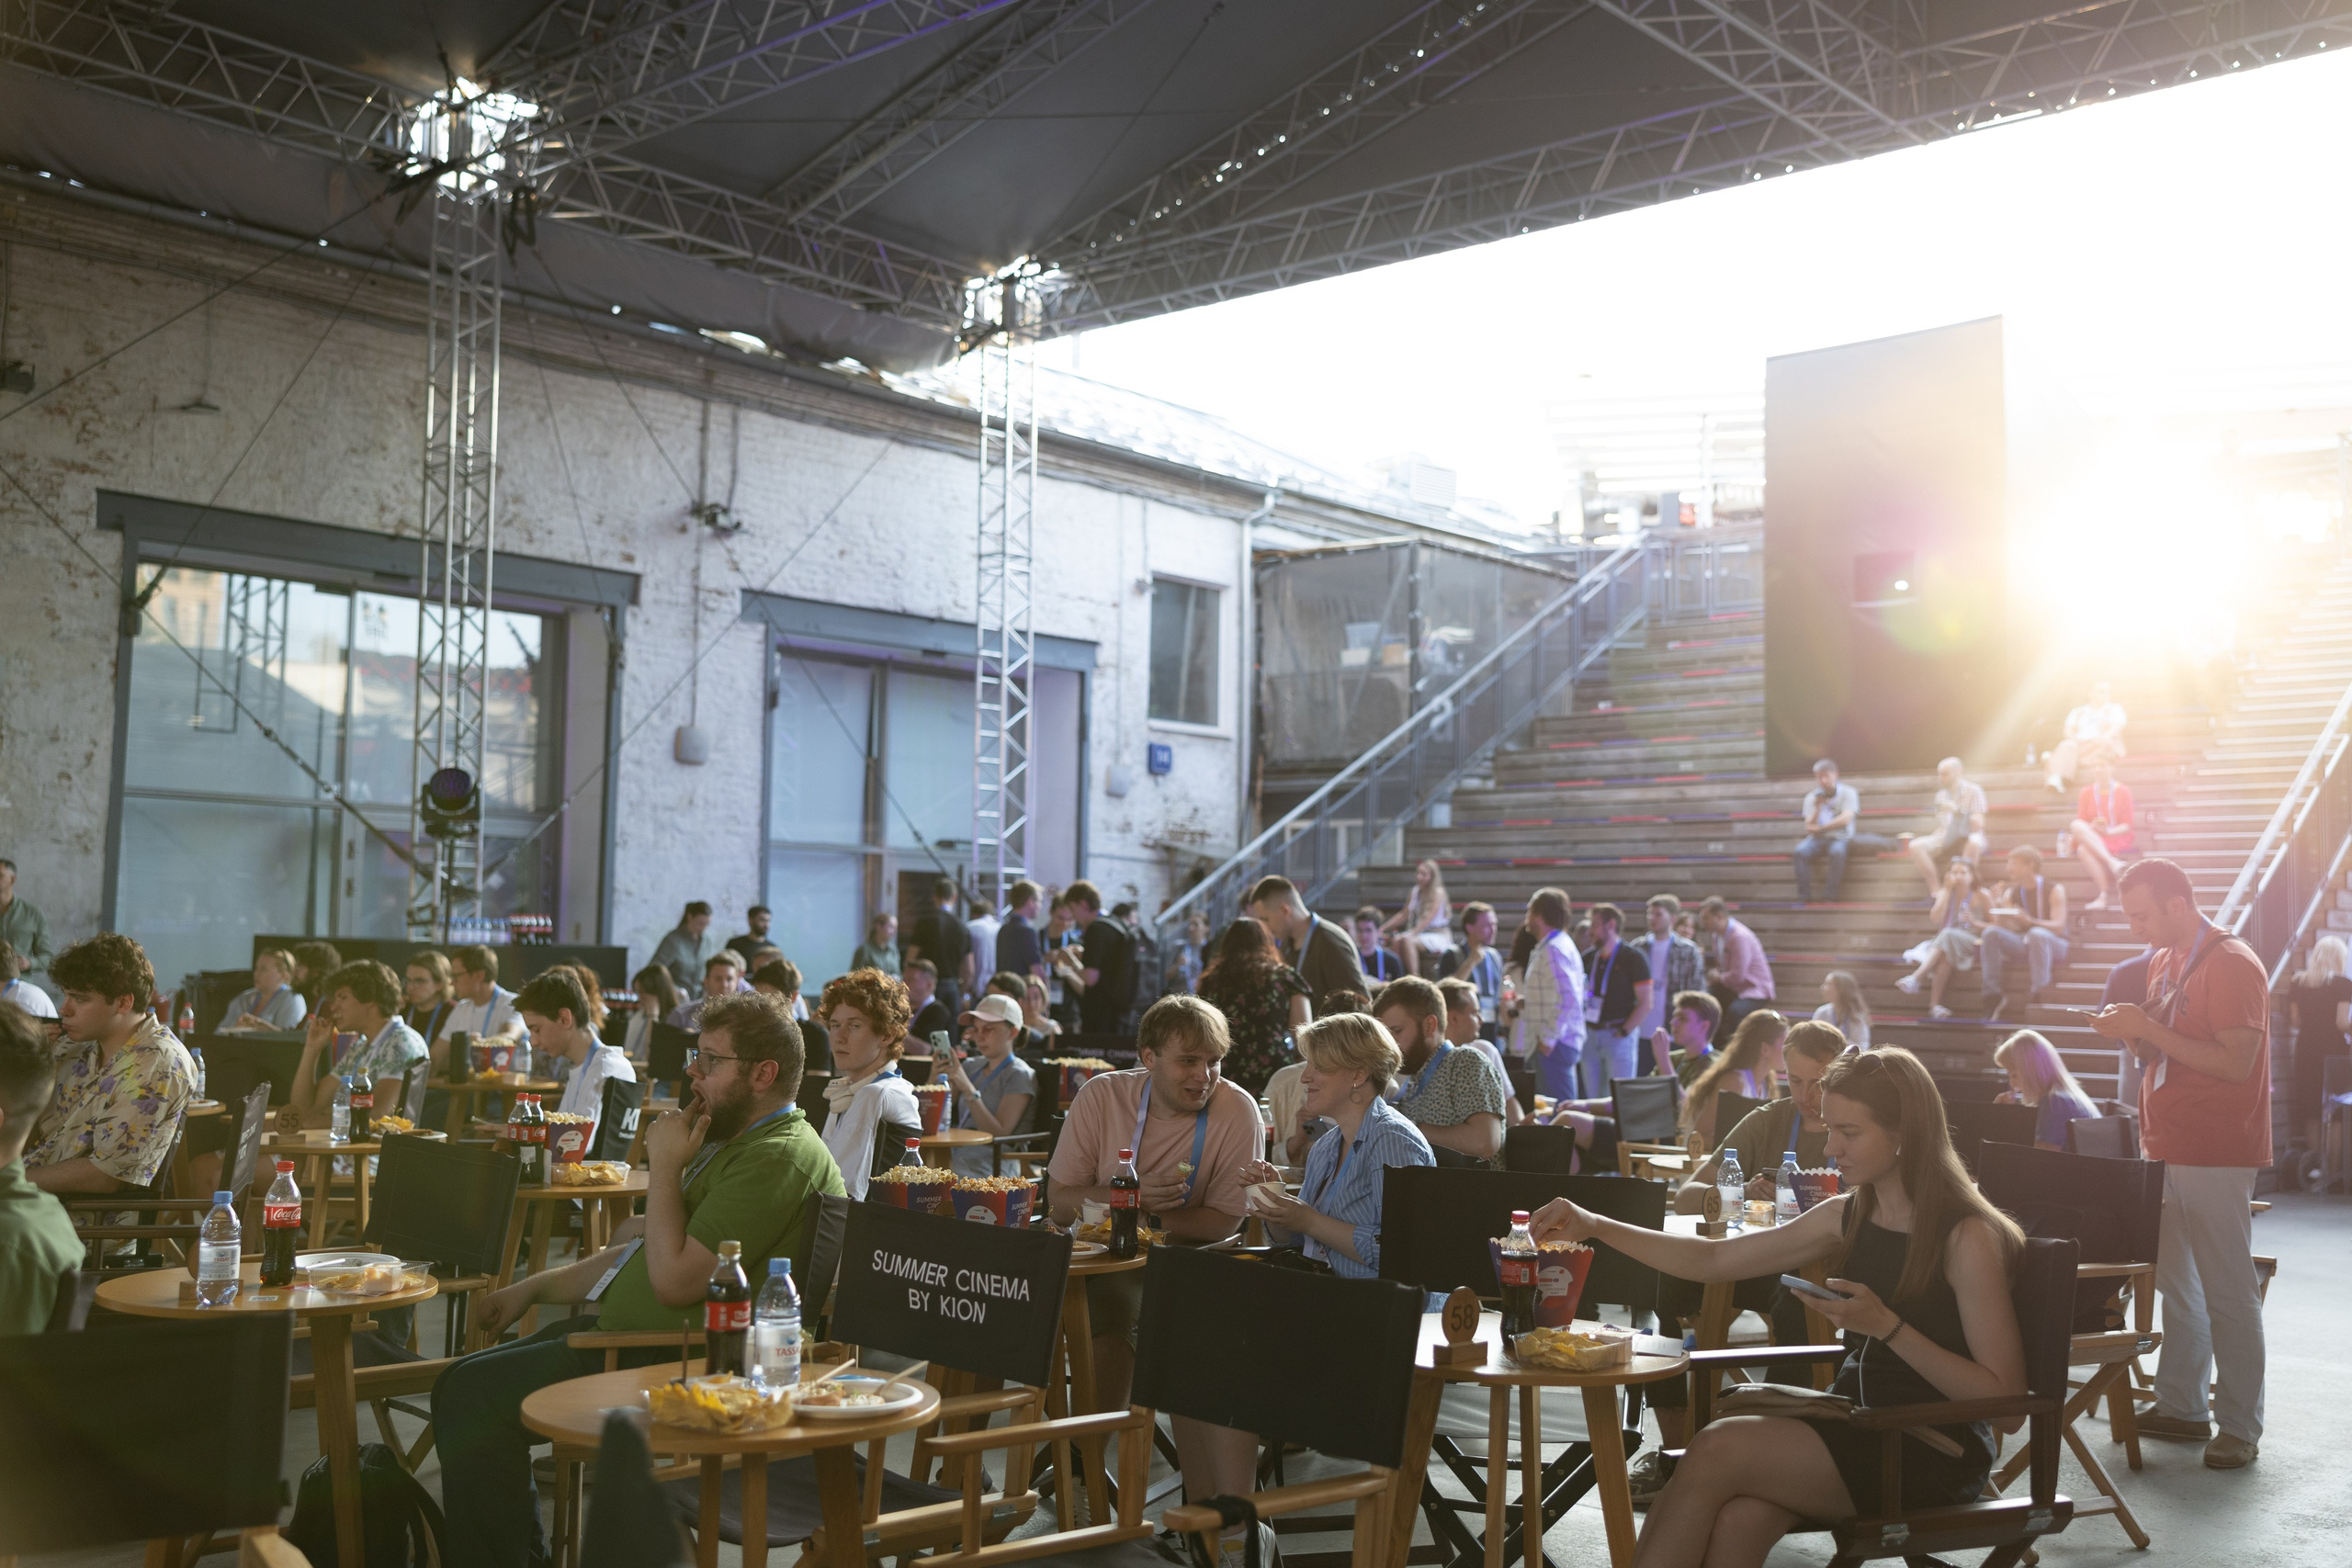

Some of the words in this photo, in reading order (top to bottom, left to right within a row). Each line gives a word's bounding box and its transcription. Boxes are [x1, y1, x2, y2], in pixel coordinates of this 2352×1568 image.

[279, 1113, 300, 1128] 55
[1690, 1140, 1701, 1155] 72
[1011, 1201, 1028, 1211] SUMMER
[1706, 1196, 1719, 1214] 65
[872, 1249, 948, 1287] SUMMER
[956, 1269, 1030, 1302] CINEMA
[908, 1288, 930, 1312] BY
[940, 1294, 986, 1324] KION
[1451, 1303, 1474, 1332] 58
